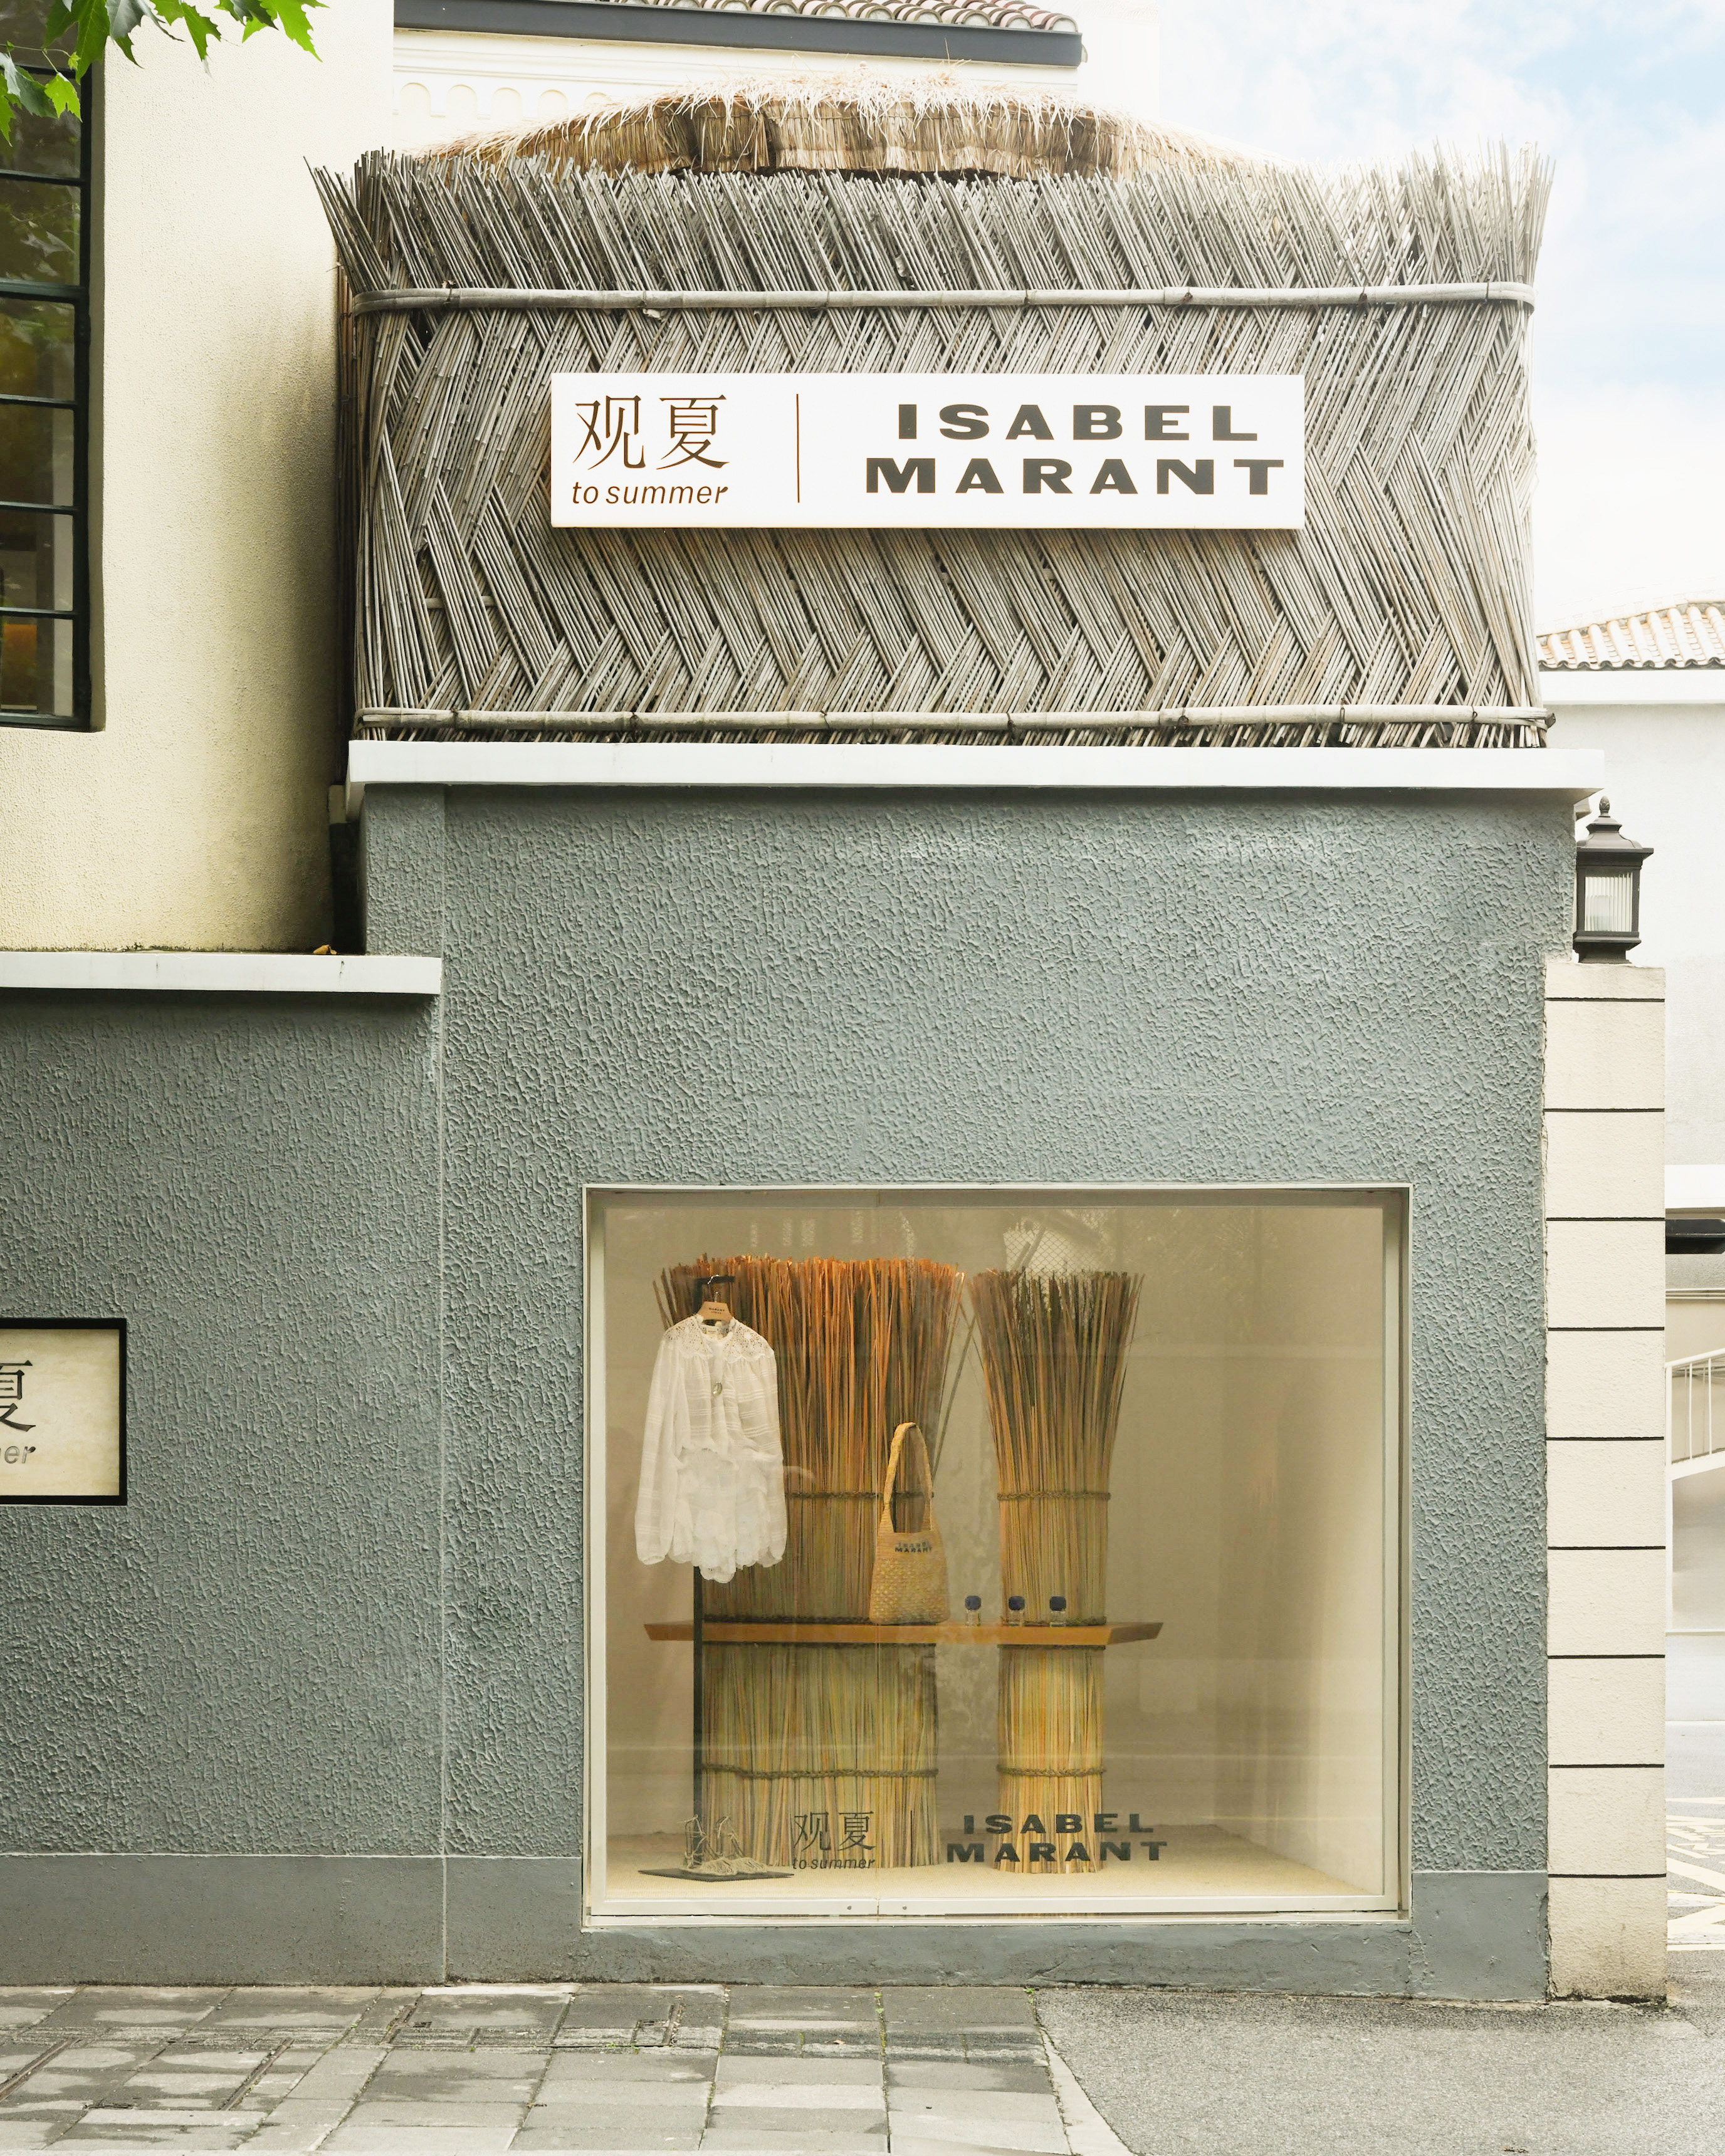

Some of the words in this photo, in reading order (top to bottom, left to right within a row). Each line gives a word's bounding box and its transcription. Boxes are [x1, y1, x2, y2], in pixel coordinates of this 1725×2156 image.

[573, 394, 729, 471] 观夏
[898, 404, 1257, 441] ISABEL
[866, 458, 1284, 495] MARANT
[572, 481, 599, 504] to
[606, 486, 729, 504] summer
[0, 1445, 36, 1464] er
[793, 1811, 876, 1851] 观夏
[963, 1813, 1154, 1834] ISABEL
[792, 1857, 807, 1870] to
[810, 1858, 876, 1870] summer
[946, 1841, 1167, 1863] MARANT
